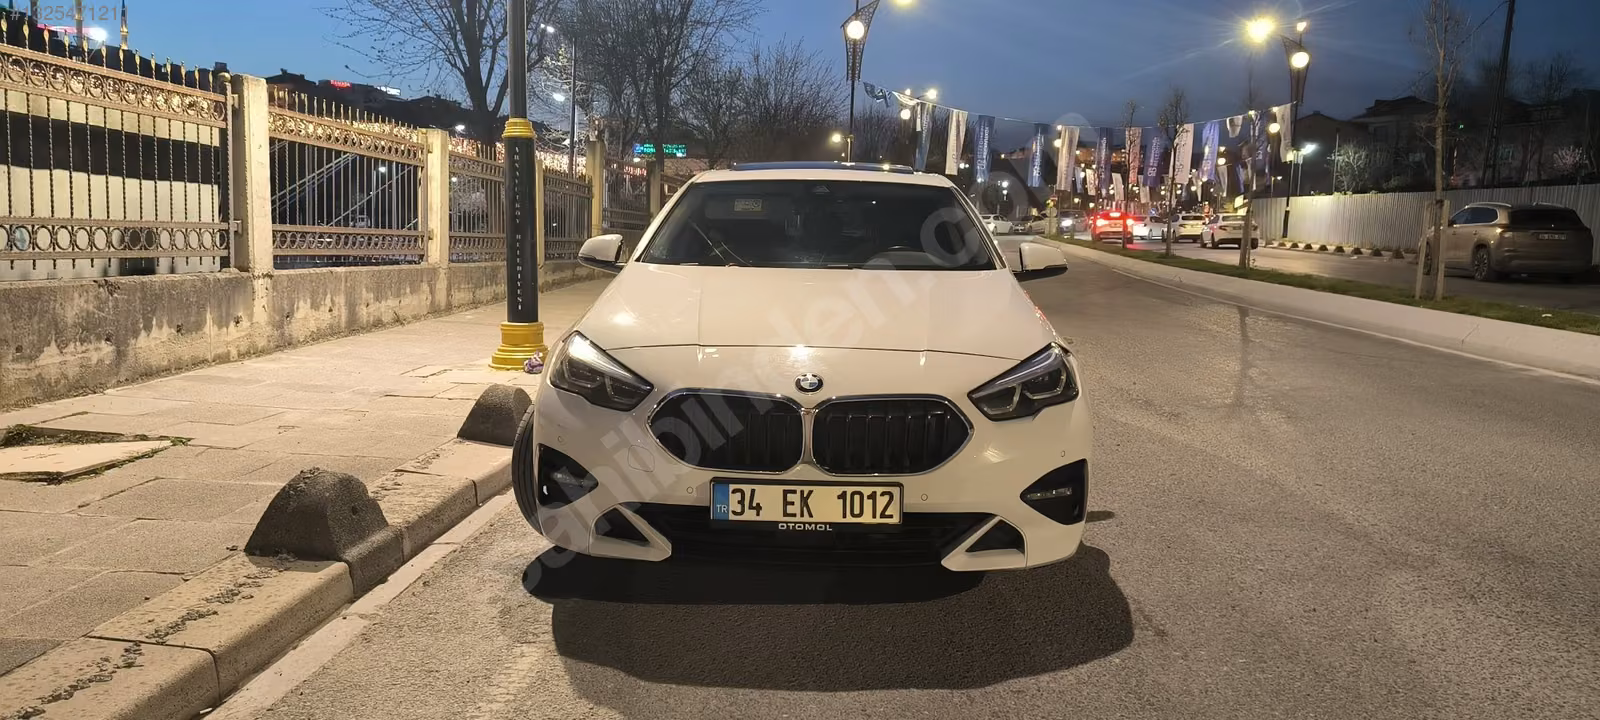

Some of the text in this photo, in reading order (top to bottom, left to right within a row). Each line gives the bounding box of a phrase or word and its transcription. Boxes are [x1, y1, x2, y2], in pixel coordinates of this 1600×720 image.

[716, 488, 894, 519] TR 34 EK 1012
[778, 523, 833, 531] OTOMOL
